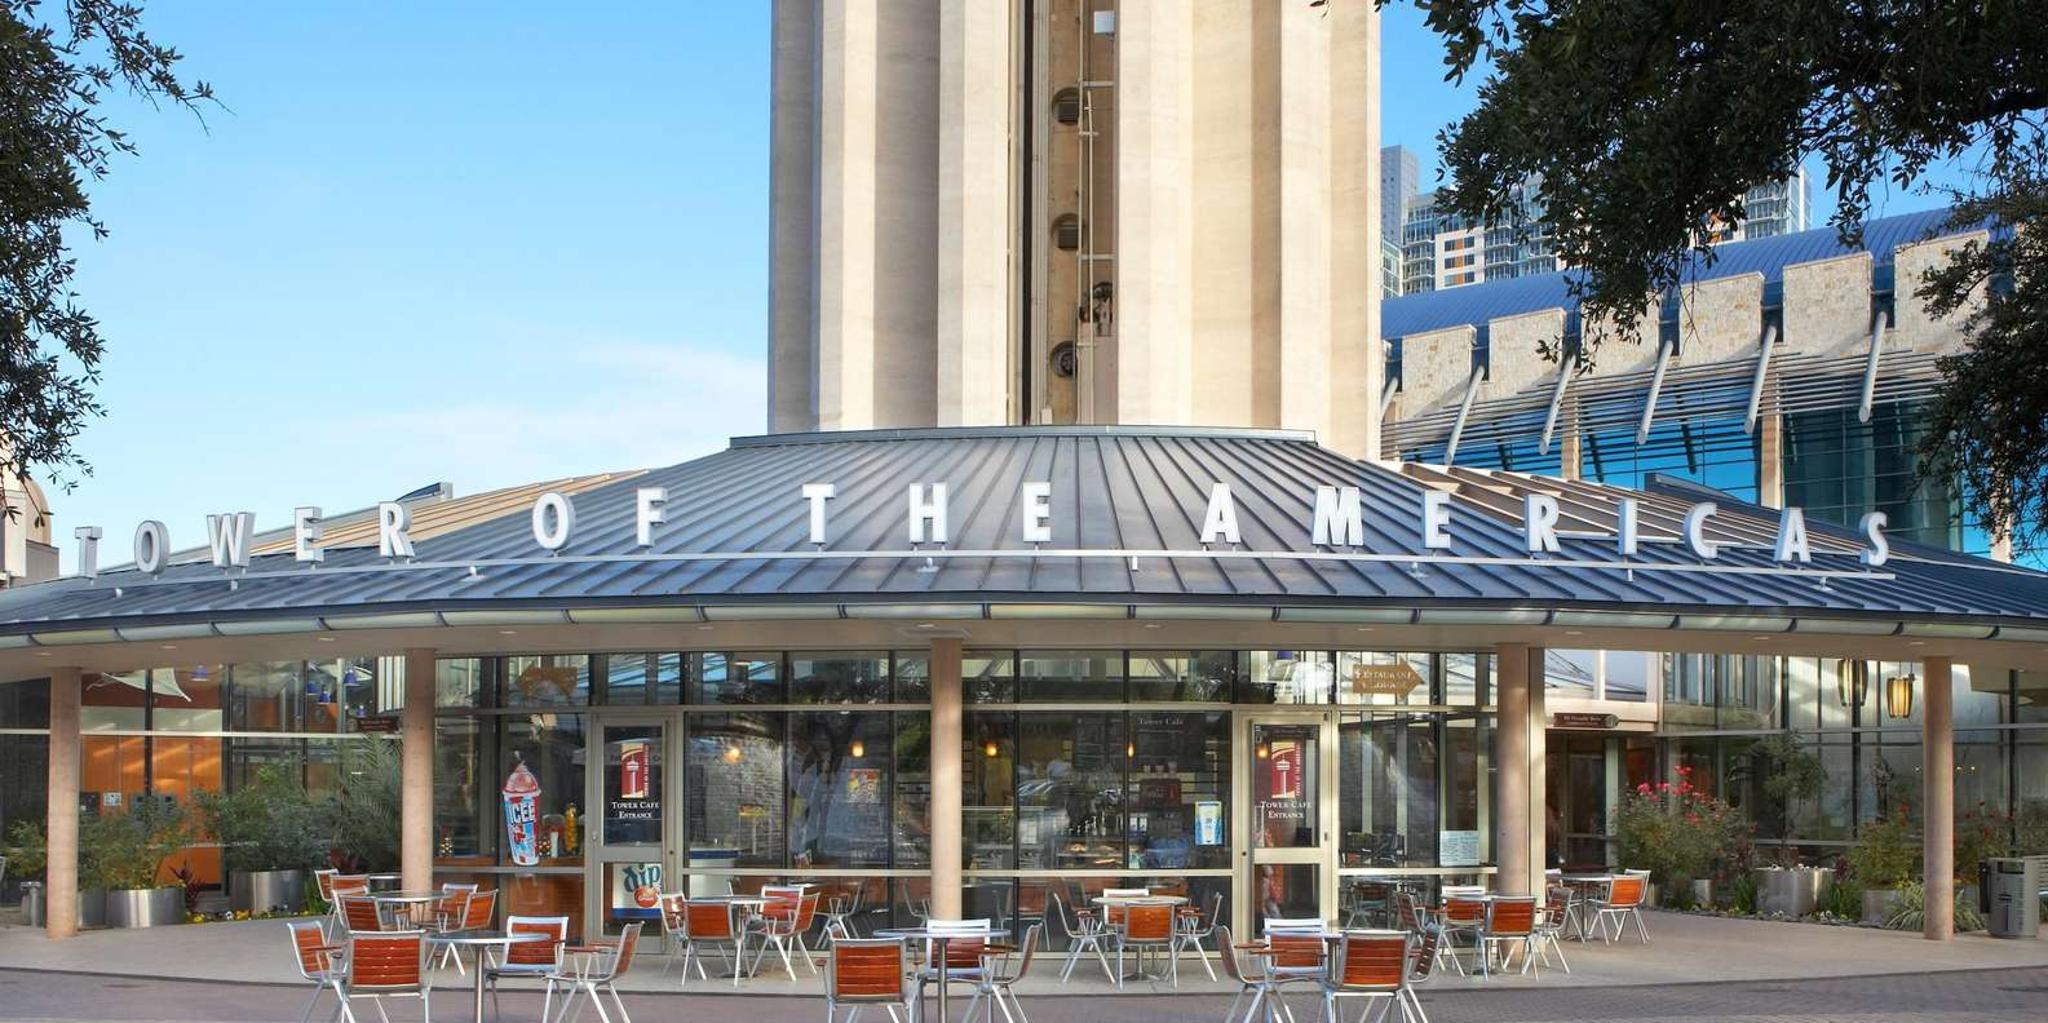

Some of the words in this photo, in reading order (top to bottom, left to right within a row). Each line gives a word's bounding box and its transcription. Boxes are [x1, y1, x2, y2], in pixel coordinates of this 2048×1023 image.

[75, 499, 415, 579] TOWER
[532, 487, 668, 552] OF
[803, 482, 1051, 543] THE
[1201, 482, 1889, 567] AMERICAS
[622, 863, 661, 893] dip
